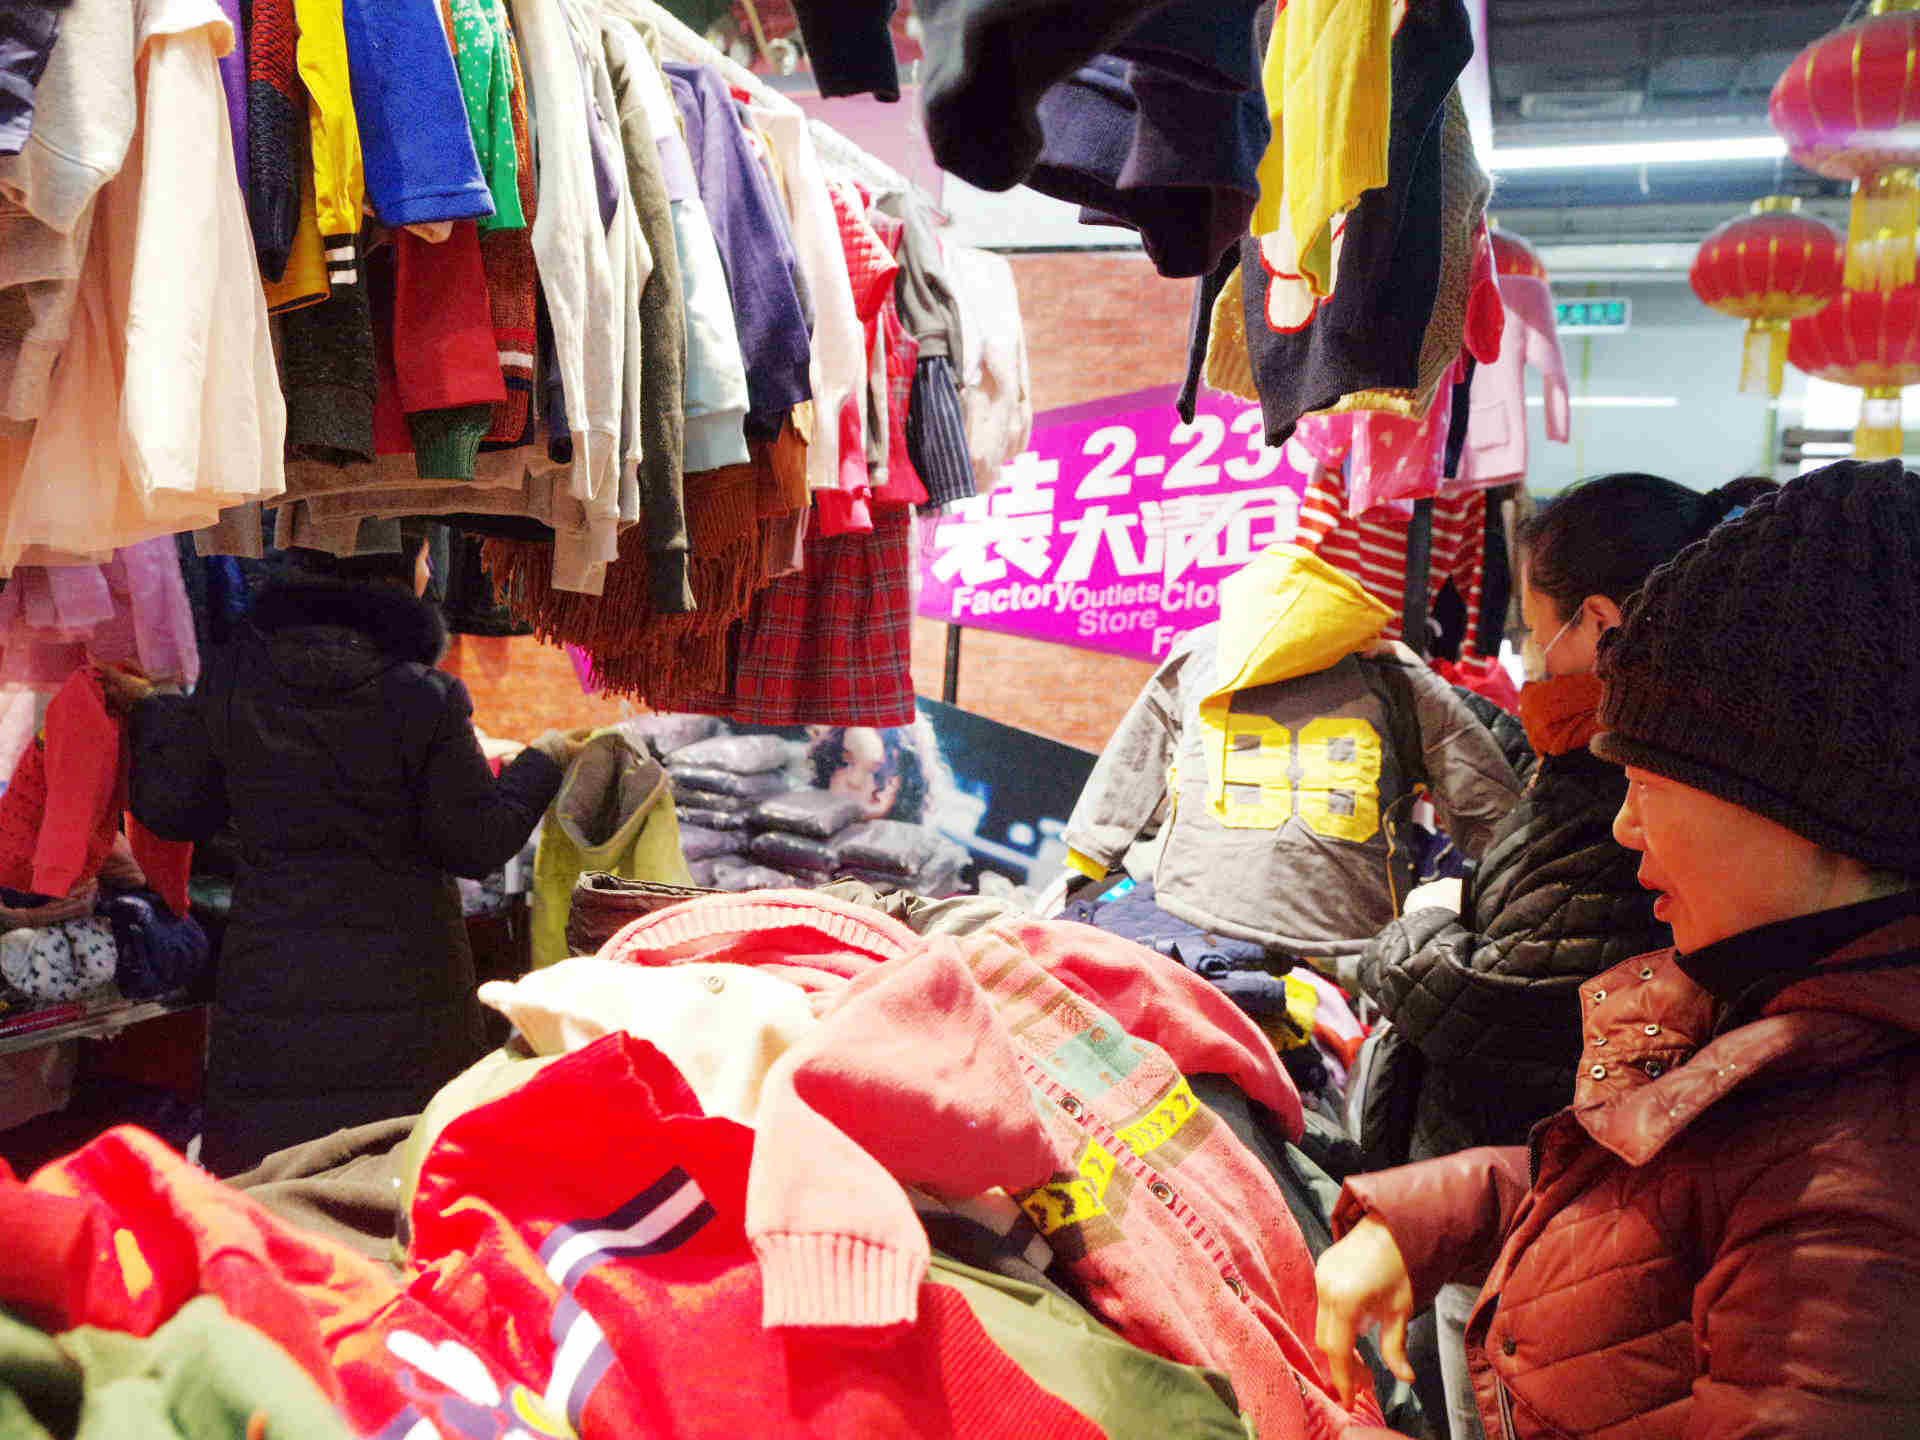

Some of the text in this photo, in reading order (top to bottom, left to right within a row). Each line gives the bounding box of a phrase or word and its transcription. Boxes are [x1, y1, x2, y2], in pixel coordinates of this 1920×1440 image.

[951, 580, 1074, 618] Factory
[1070, 582, 1160, 611] Outlets
[1076, 608, 1159, 636] Store
